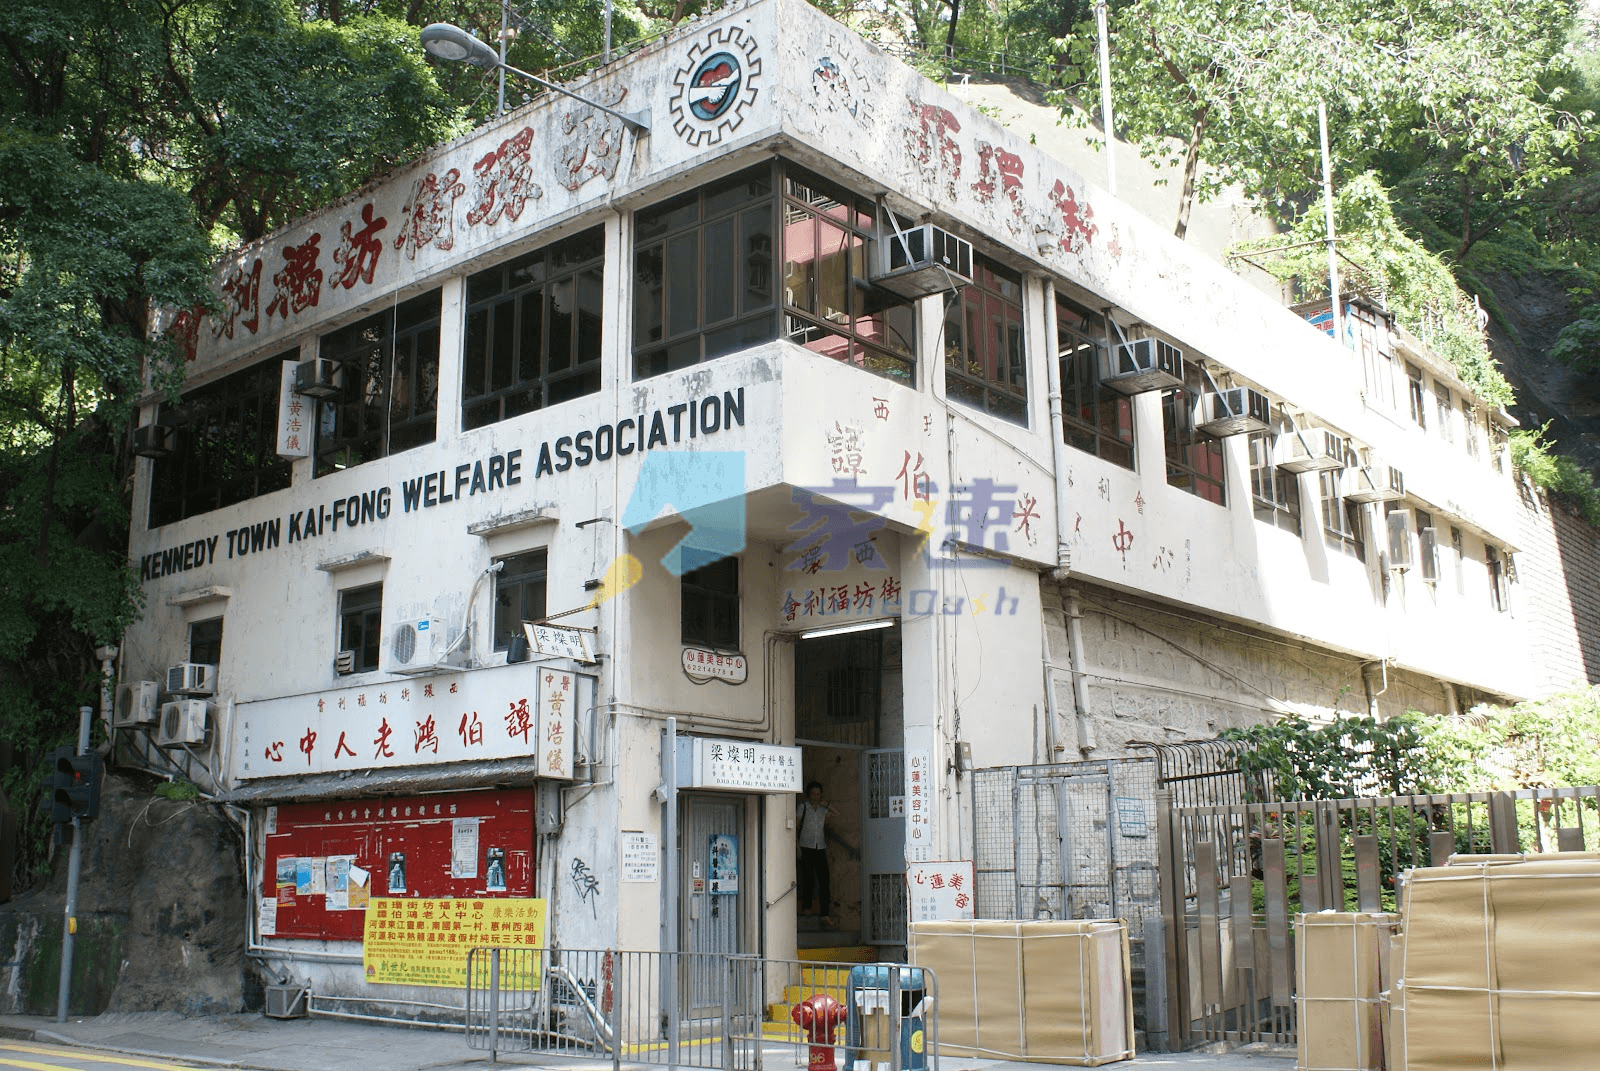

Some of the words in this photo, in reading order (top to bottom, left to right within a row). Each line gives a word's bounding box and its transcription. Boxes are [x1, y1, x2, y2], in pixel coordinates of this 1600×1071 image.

[140, 534, 218, 580] KENNEDY
[226, 517, 280, 560] TOWN
[288, 486, 391, 543] KAI-FONG
[402, 449, 522, 514] WELFARE
[535, 387, 746, 475] ASSOCIATION
[687, 651, 743, 668] 心蓮美容中心
[545, 672, 571, 692] 中醫
[711, 743, 755, 764] 梁燦明
[760, 754, 795, 767] 牙科醫生
[911, 756, 922, 839] 心蓮美容中心
[914, 870, 970, 909] 心蓮美容
